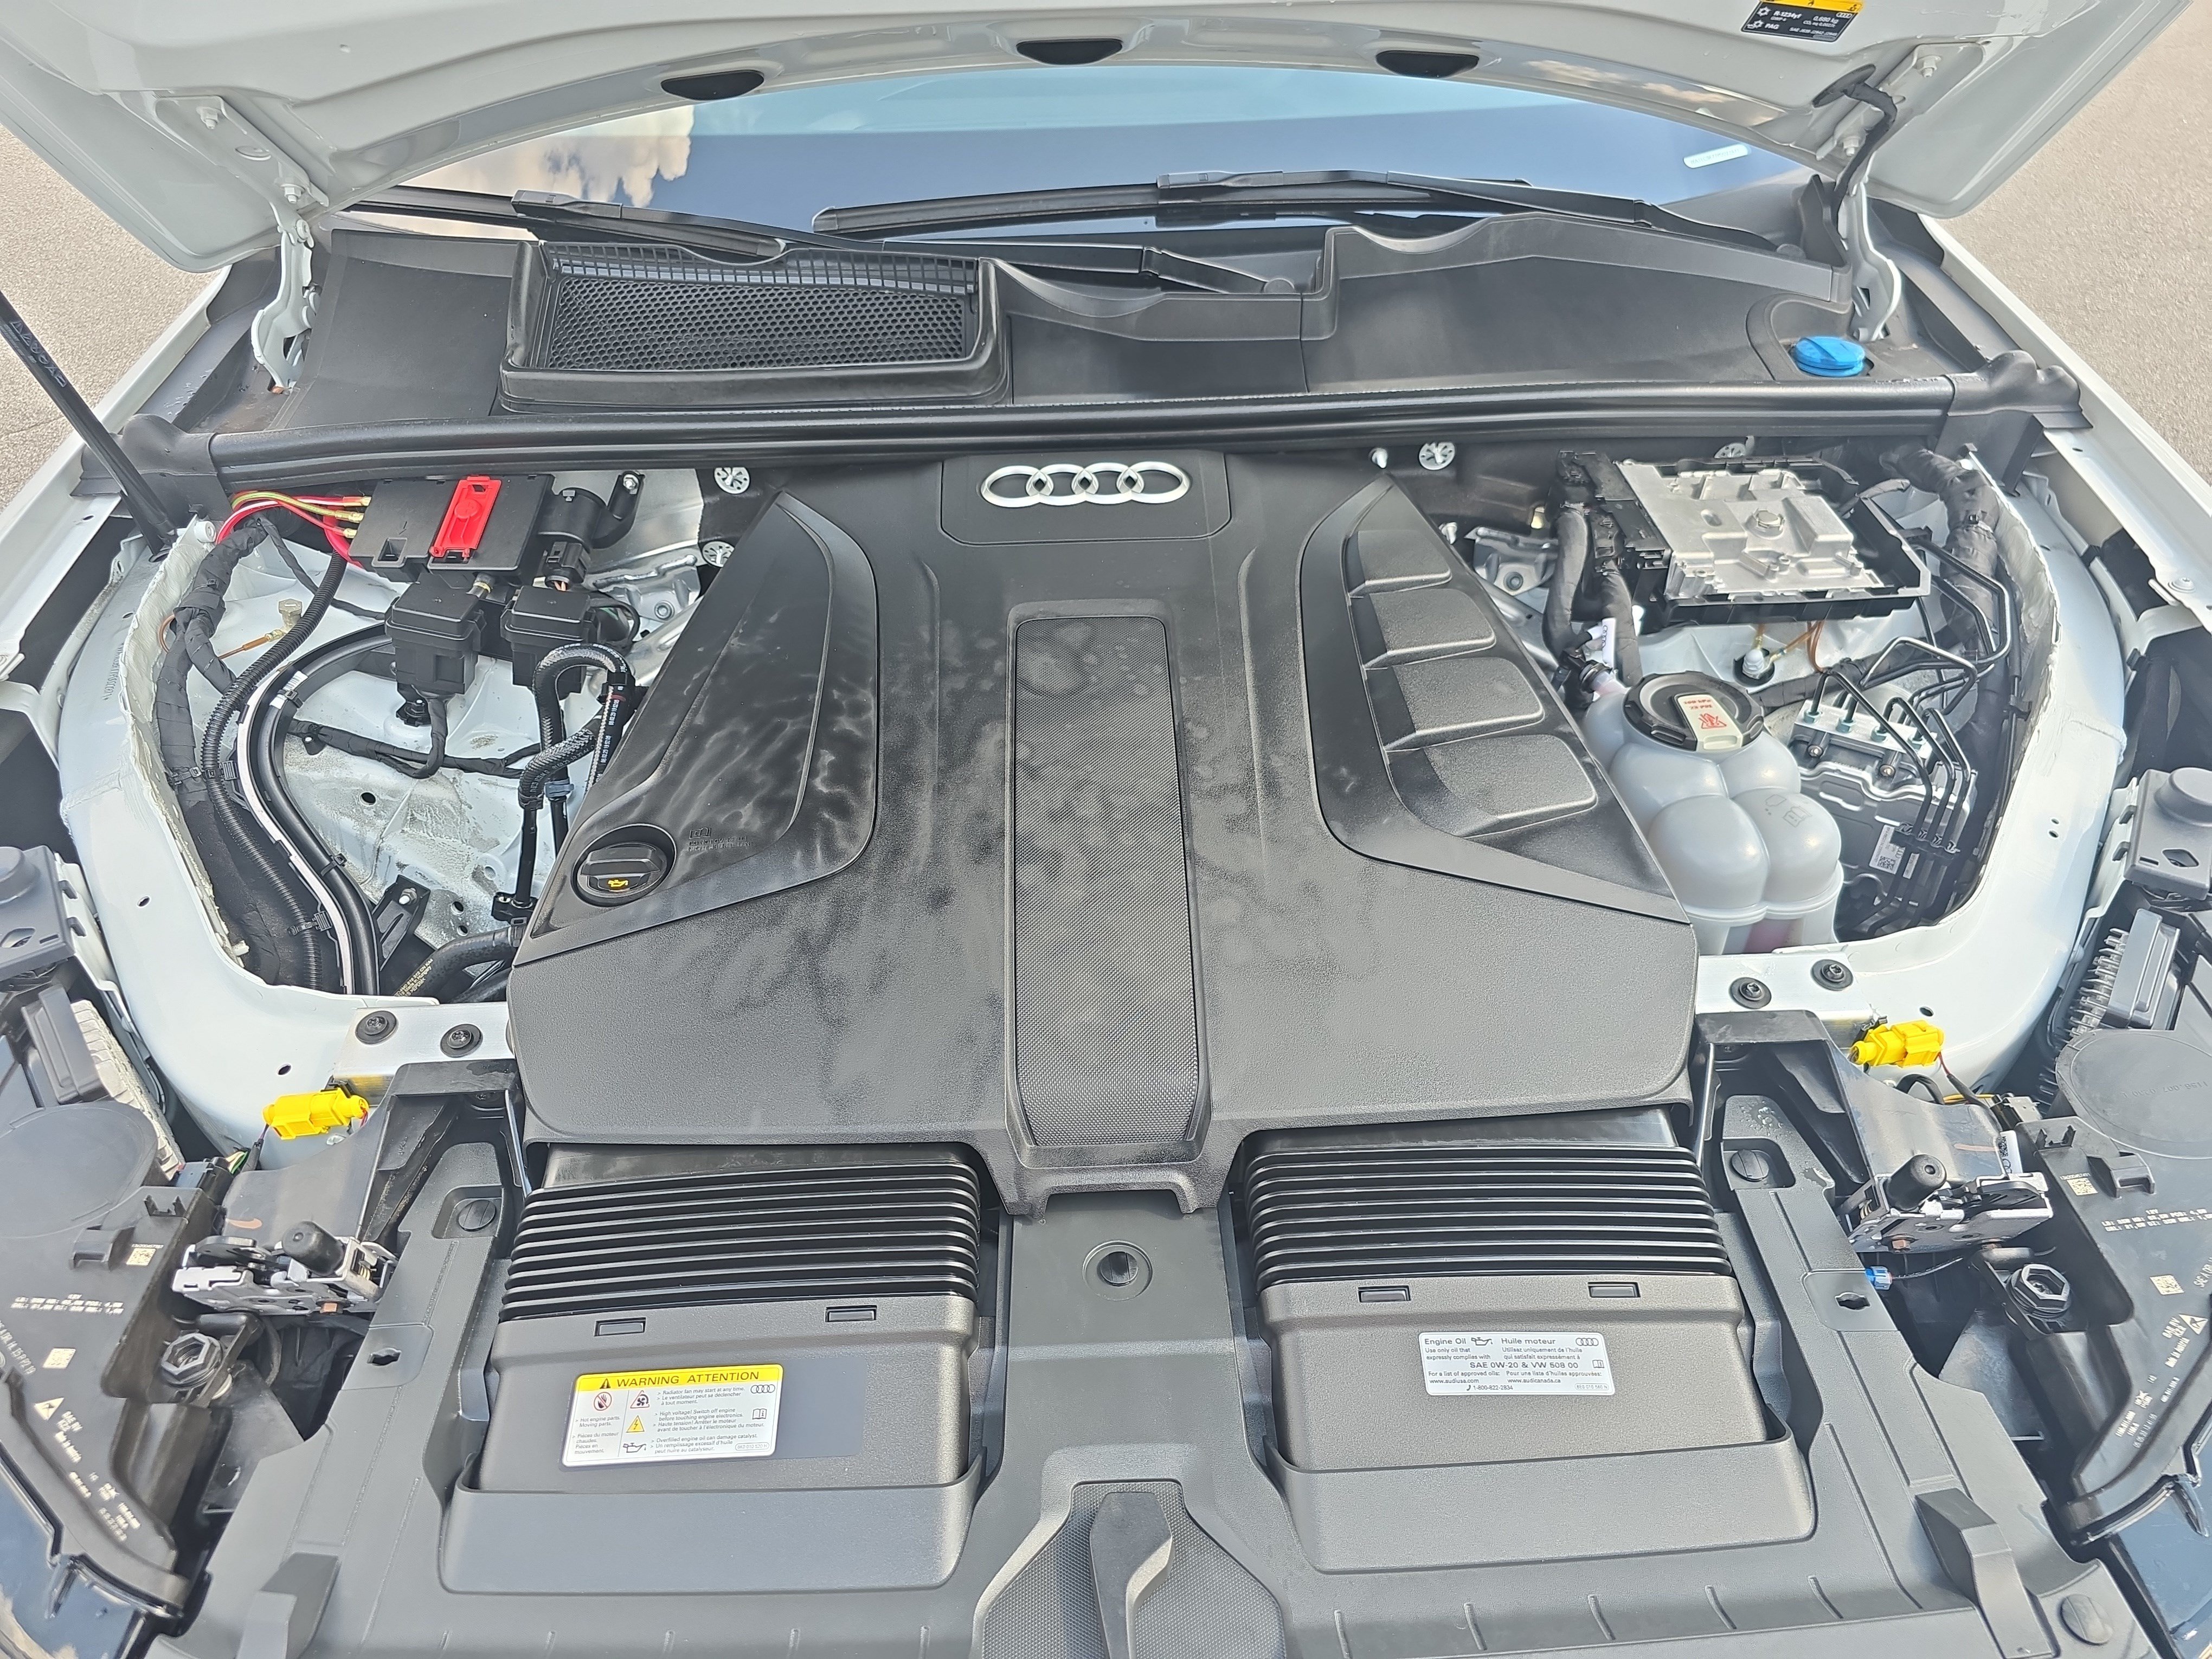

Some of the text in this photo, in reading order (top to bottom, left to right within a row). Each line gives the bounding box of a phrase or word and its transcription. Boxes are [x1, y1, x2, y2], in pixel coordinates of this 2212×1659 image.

[404, 982, 415, 993] Made
[416, 965, 432, 980] Hungary
[1424, 1338, 1452, 1346] Engine
[616, 1371, 759, 1387] WARNING ATTENTION
